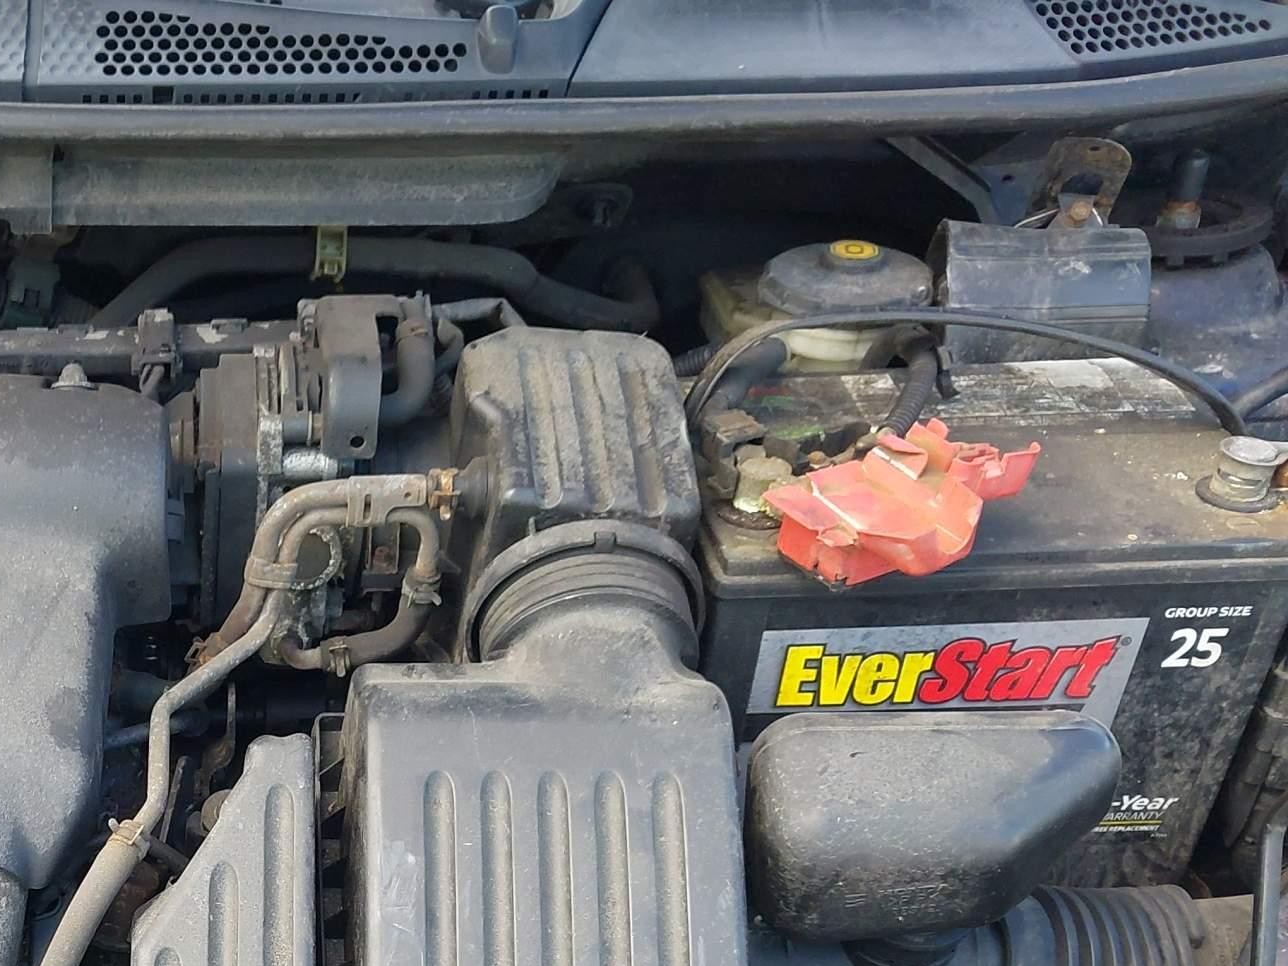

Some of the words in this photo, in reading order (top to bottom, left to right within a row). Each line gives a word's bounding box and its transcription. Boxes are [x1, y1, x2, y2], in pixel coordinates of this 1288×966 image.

[1165, 606, 1217, 619] GROUP
[1219, 605, 1253, 617] SIZE
[1160, 628, 1229, 668] 25
[775, 634, 1121, 707] EverStart
